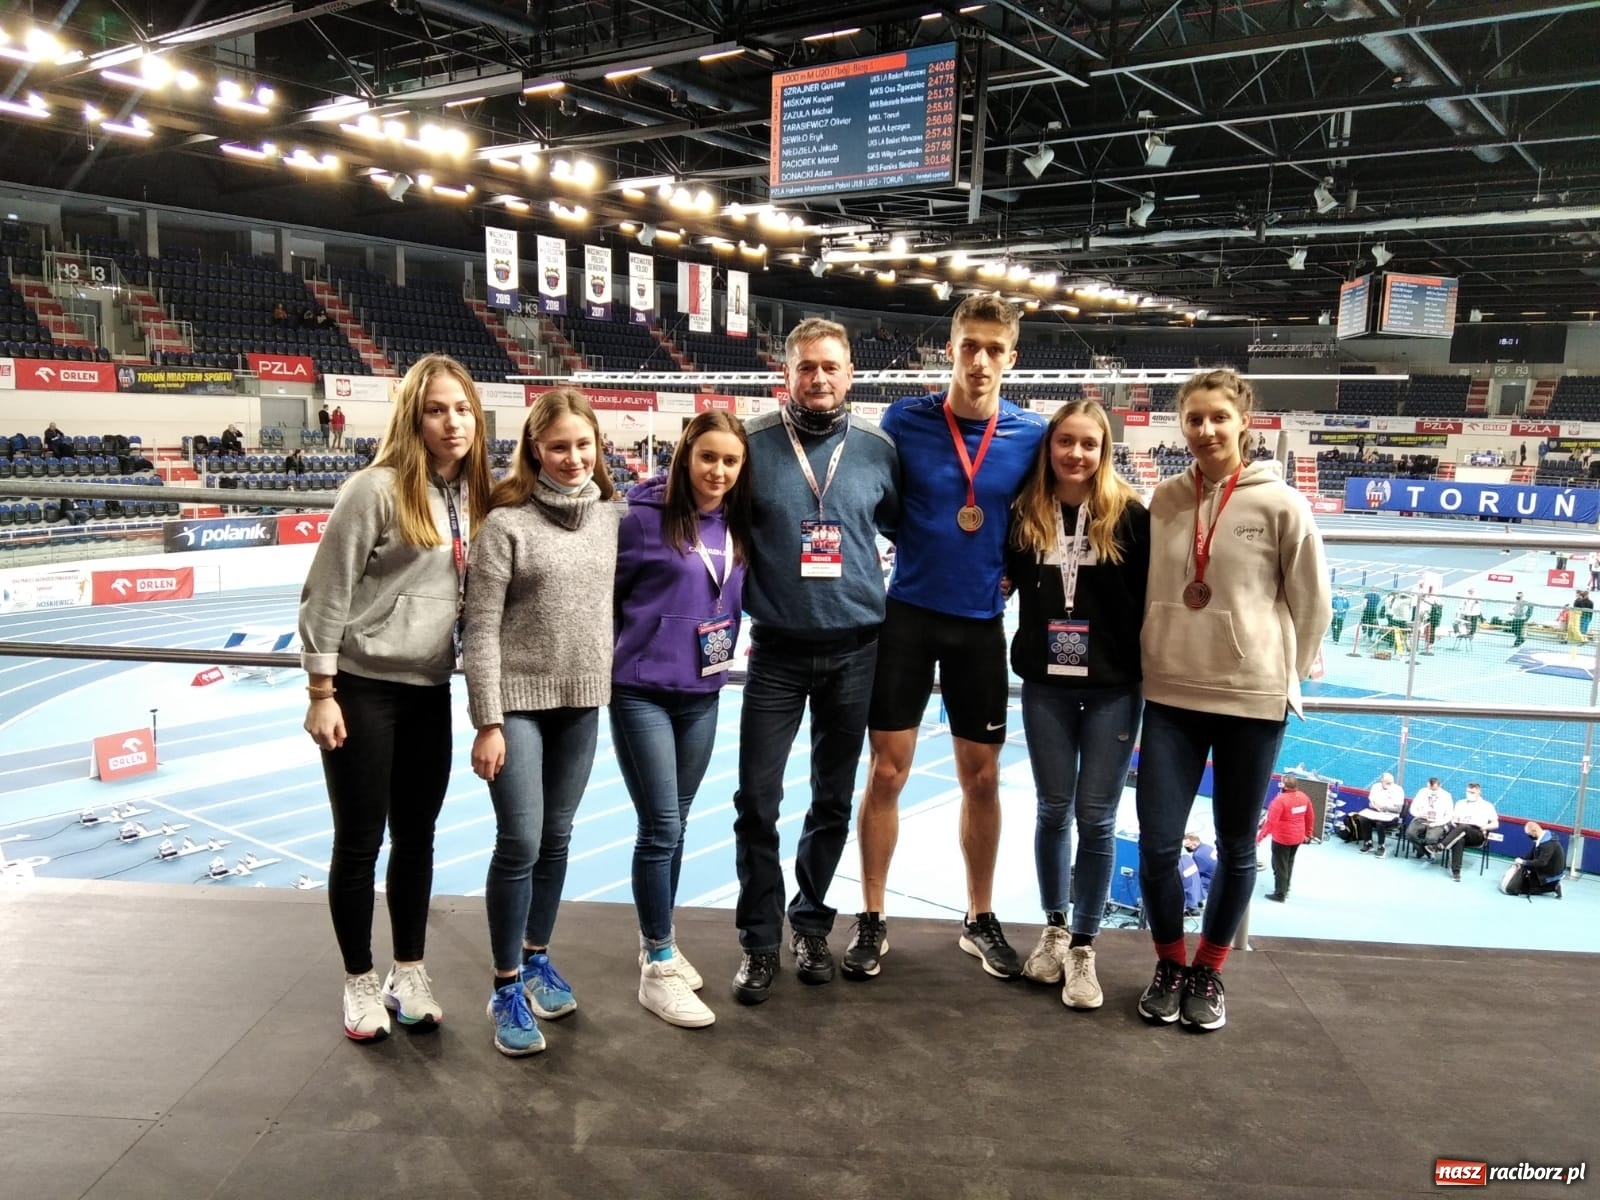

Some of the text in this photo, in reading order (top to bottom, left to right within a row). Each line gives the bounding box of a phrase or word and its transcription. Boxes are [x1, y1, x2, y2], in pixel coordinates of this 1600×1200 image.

[784, 84, 819, 96] SZRAJNER
[821, 81, 845, 91] Gustaw
[928, 60, 955, 73] 2:40.69
[784, 96, 811, 108] MIŚKÓW
[928, 74, 954, 87] 2:47.75
[783, 109, 810, 120] ZAZULA
[928, 88, 954, 100] 2:51.73
[783, 119, 828, 132] TARASIEWICZ
[782, 146, 817, 157] NIEDZIELA
[819, 144, 838, 153] Jakub
[925, 128, 951, 139] 2:57.43
[810, 133, 824, 142] Eryk
[782, 158, 816, 169] PACIOREK
[782, 171, 813, 181] DONACKI
[814, 169, 832, 178] Adam
[924, 154, 950, 166] 3:01.84
[883, 174, 903, 185] TORUŃ
[525, 303, 538, 314] K3
[259, 361, 307, 376] PZLA
[63, 372, 95, 380] ORLEN
[595, 395, 621, 403] LEKKIEJ
[1519, 425, 1551, 433] PZLA
[1407, 486, 1575, 517] TORUŃ
[201, 523, 267, 546] polanik
[139, 579, 173, 590] ORLEN
[112, 755, 143, 767] ORLEN
